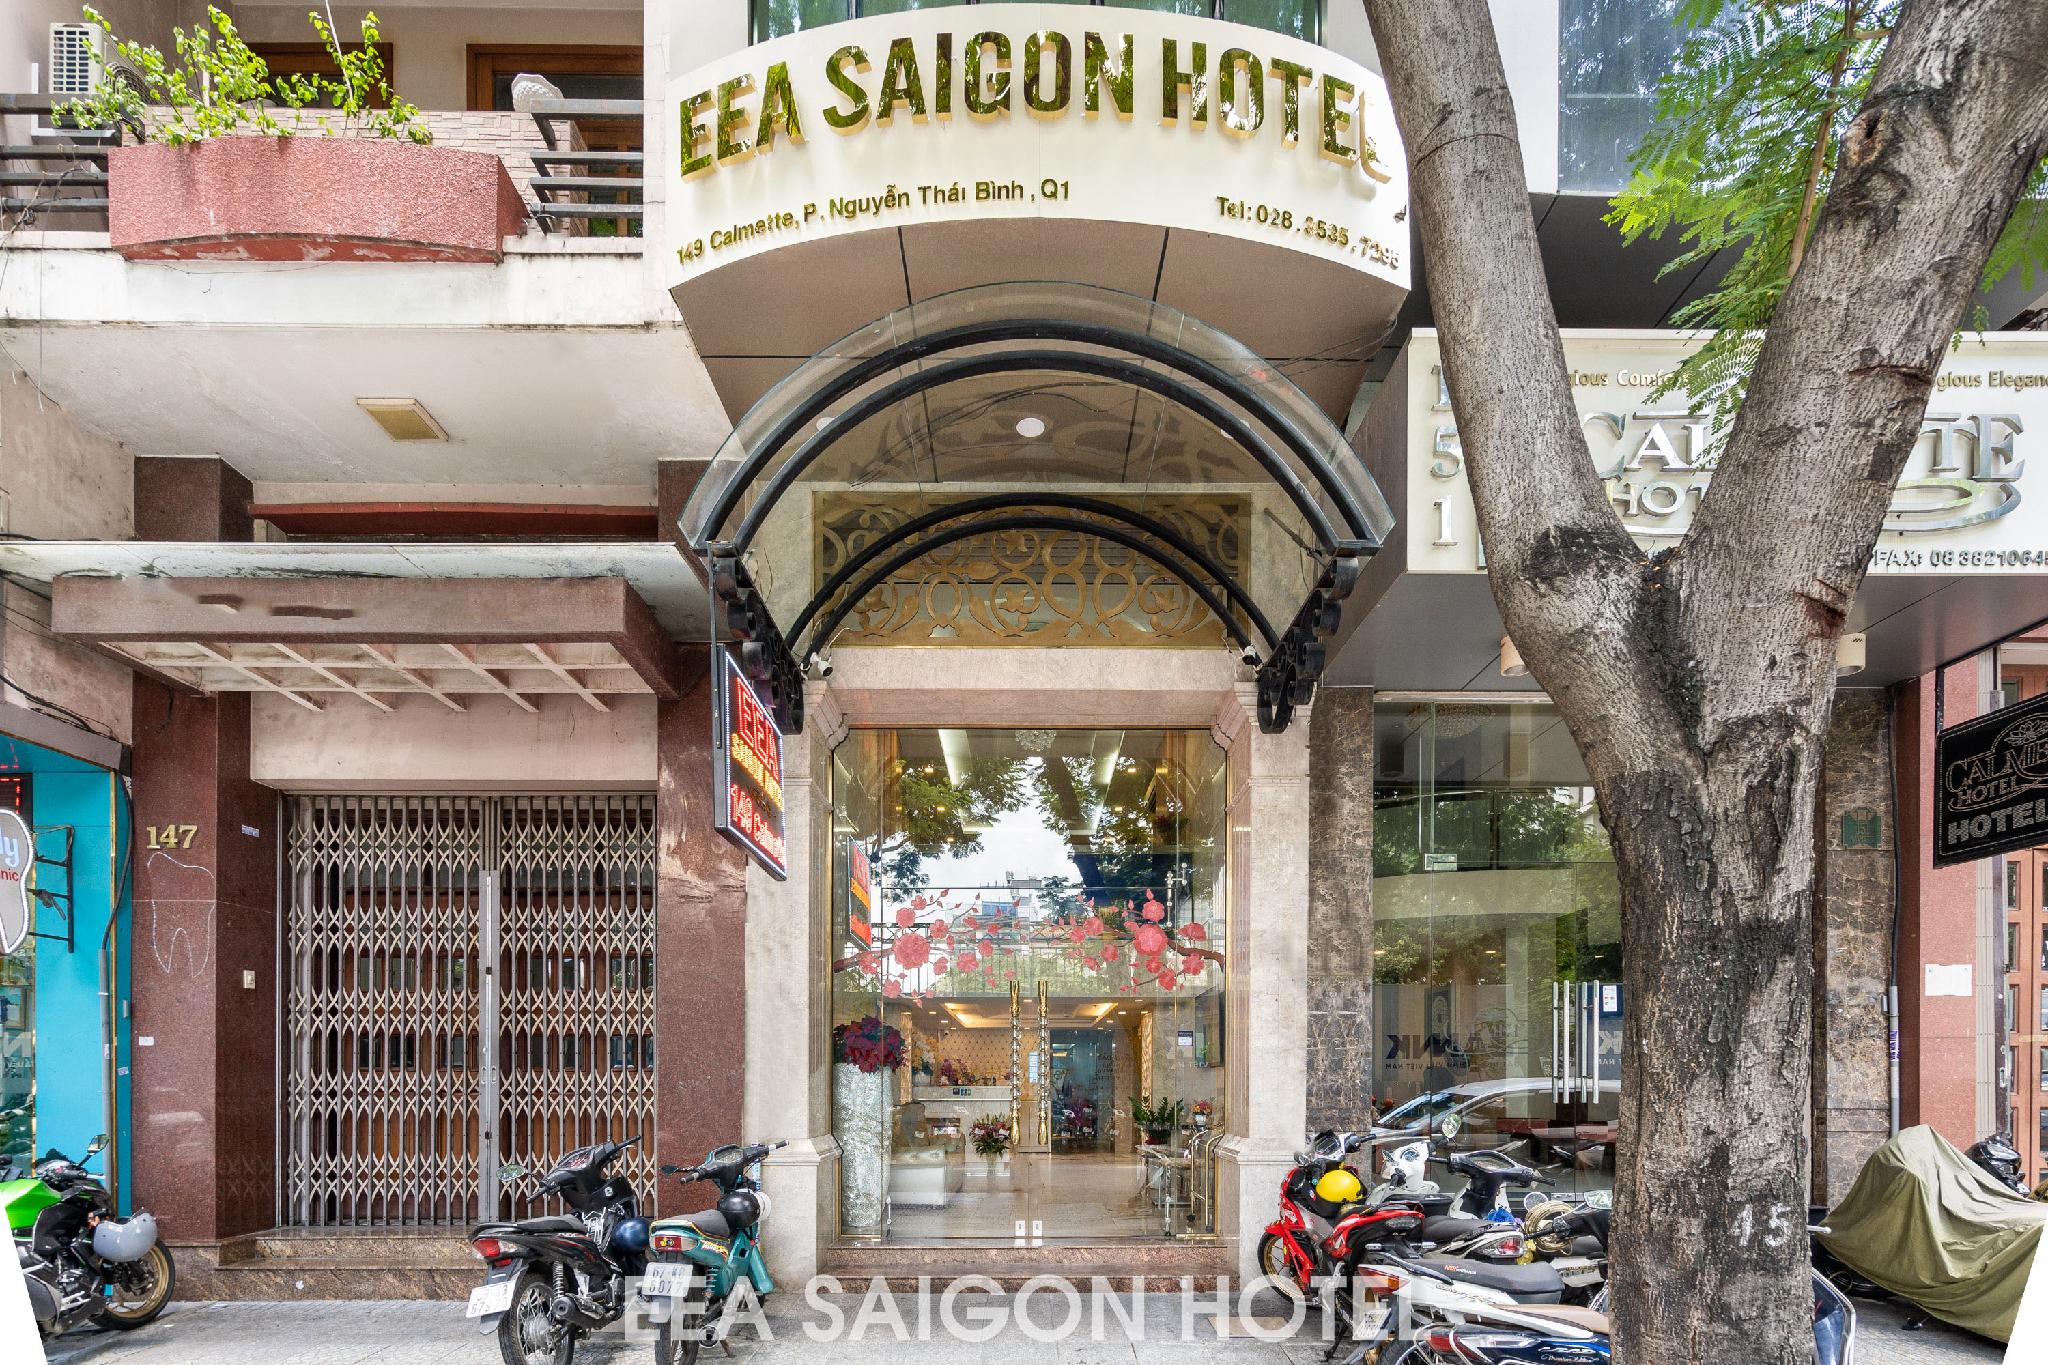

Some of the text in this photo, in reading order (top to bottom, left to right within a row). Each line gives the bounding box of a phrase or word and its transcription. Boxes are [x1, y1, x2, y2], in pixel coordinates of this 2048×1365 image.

[680, 29, 1392, 185] EEA SAIGON HOTEL
[676, 238, 704, 265] 149
[710, 209, 801, 252] Calmette,
[828, 184, 911, 219] Nguyễn
[1040, 178, 1070, 201] Q1
[1936, 370, 1983, 392] gious
[737, 676, 779, 781] EEA
[1957, 775, 2018, 808] HOTEL
[146, 824, 198, 849] 147
[1947, 798, 2048, 845] HOTEL
